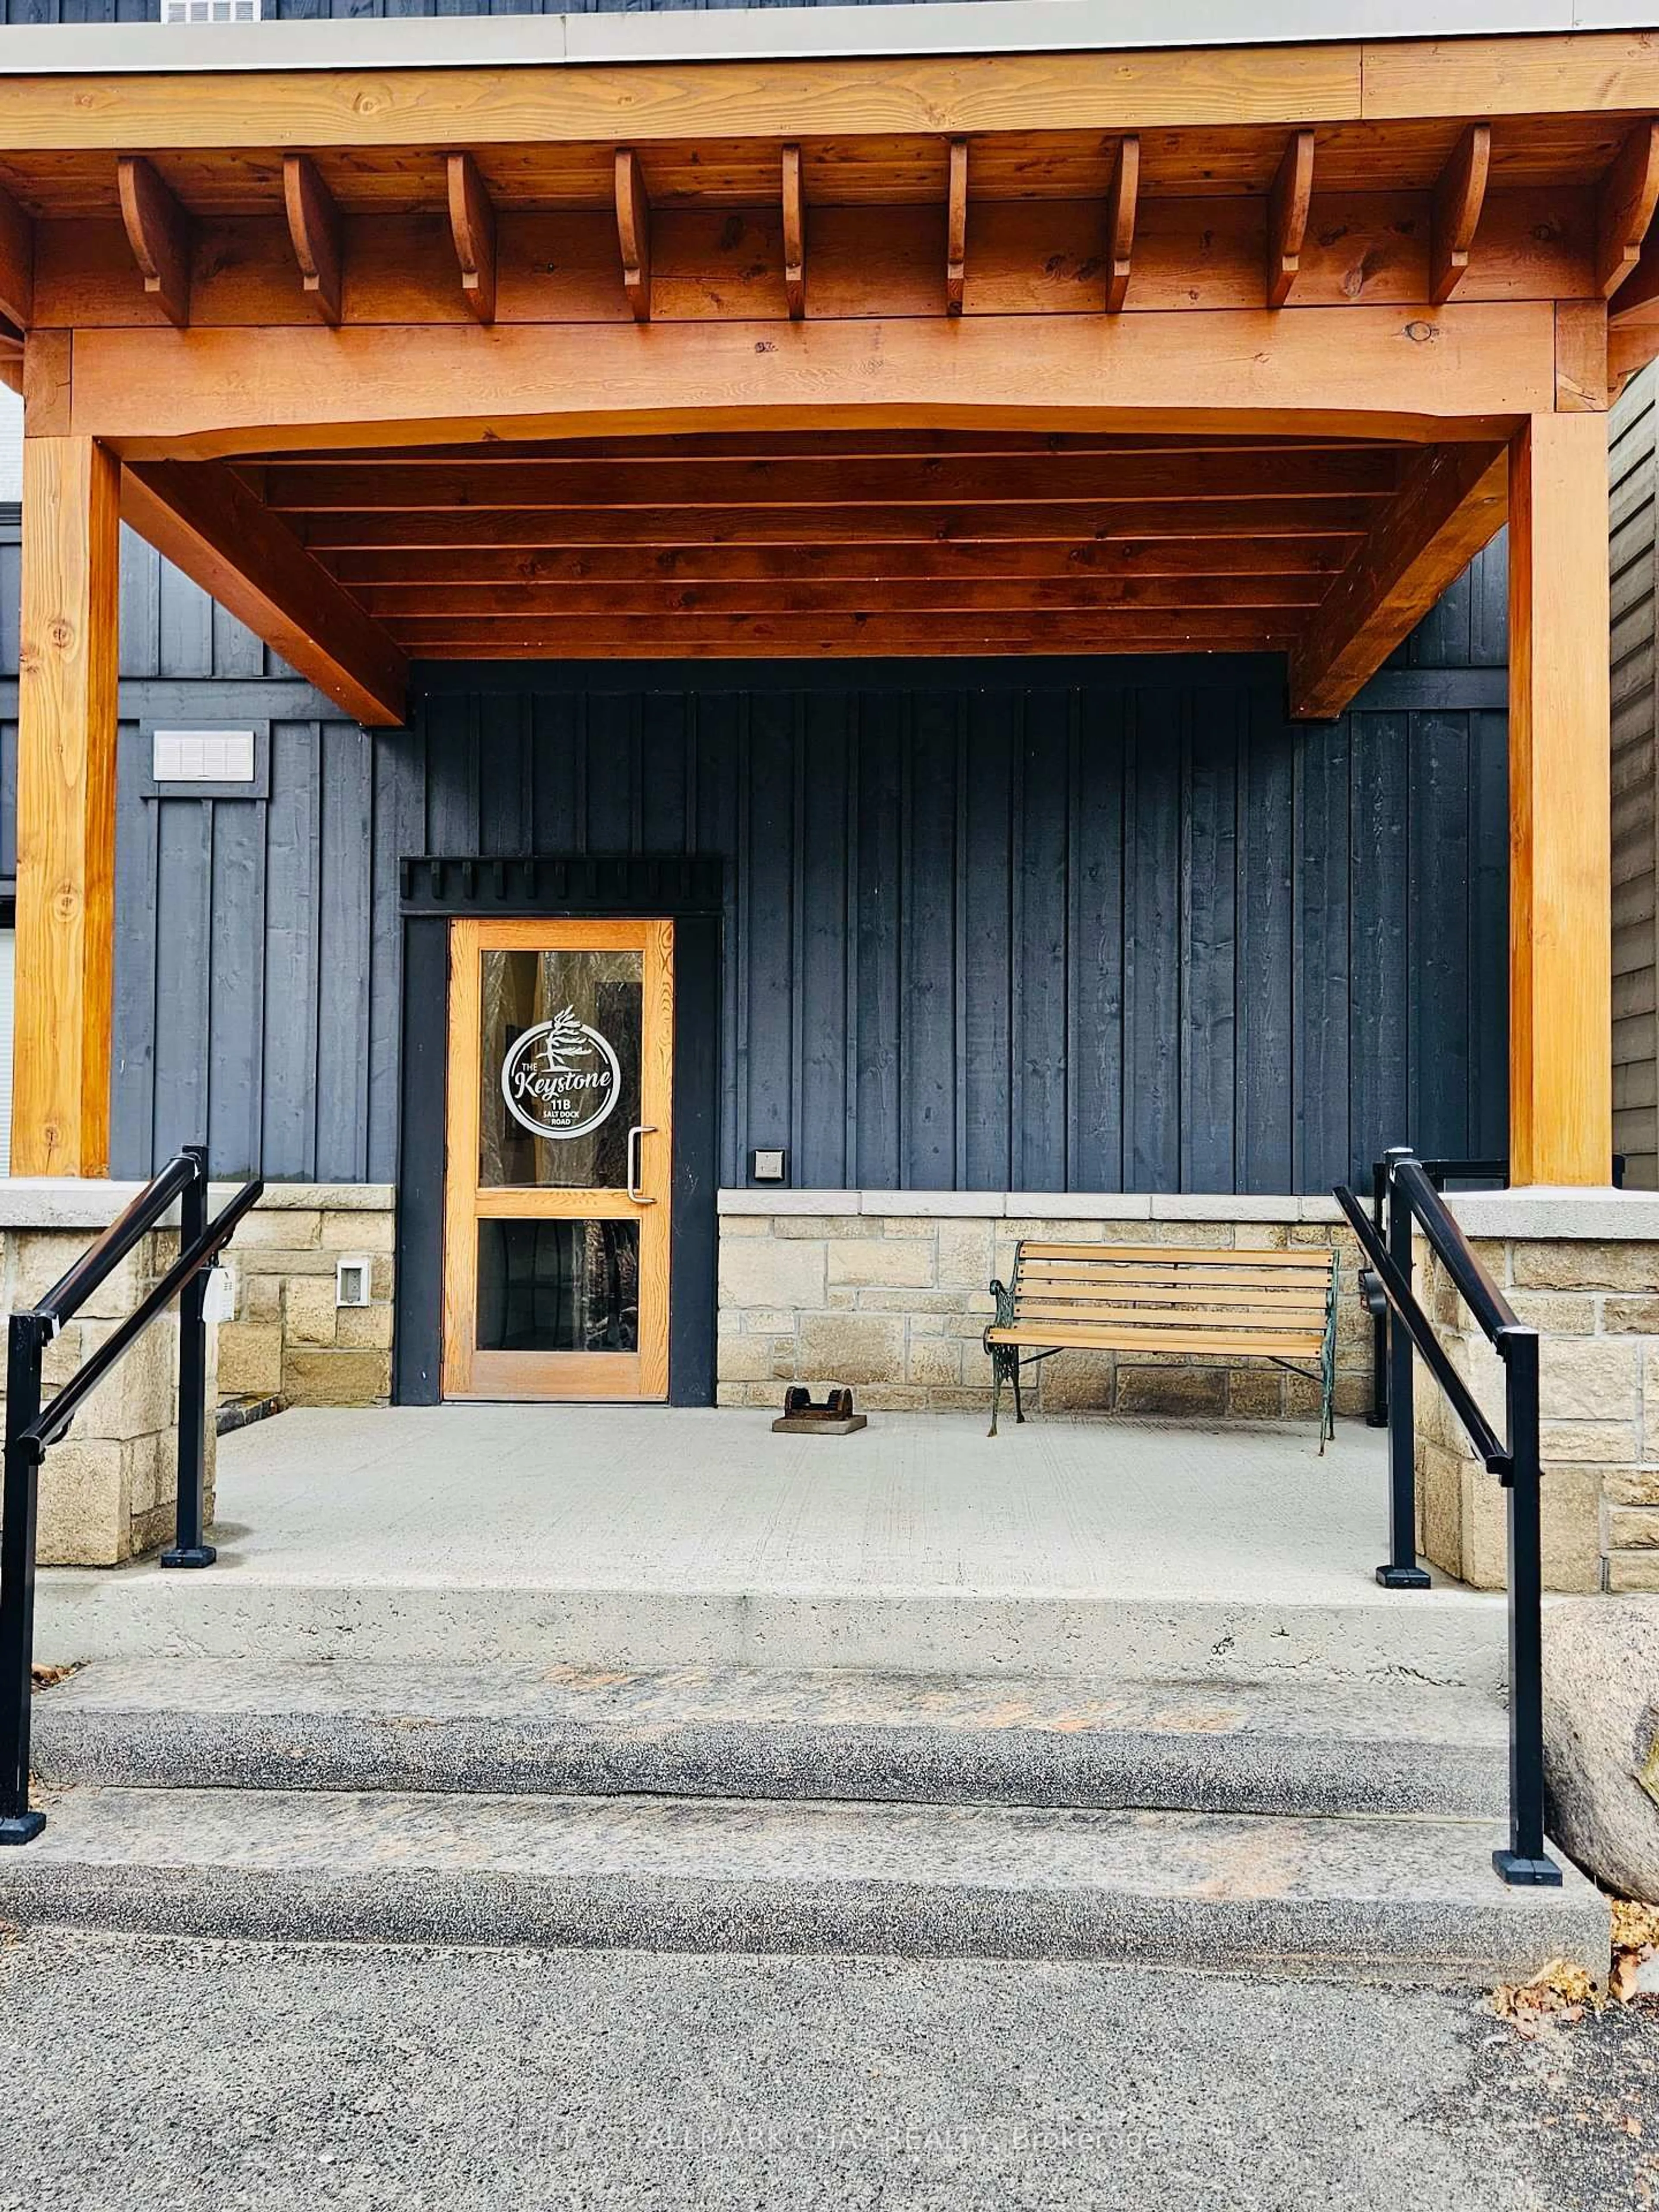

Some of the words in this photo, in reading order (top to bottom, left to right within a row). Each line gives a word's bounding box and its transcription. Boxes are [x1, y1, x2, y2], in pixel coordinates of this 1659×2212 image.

[522, 1063, 538, 1071] THE
[515, 1071, 611, 1101] Keystone
[551, 1100, 571, 1110] 11B
